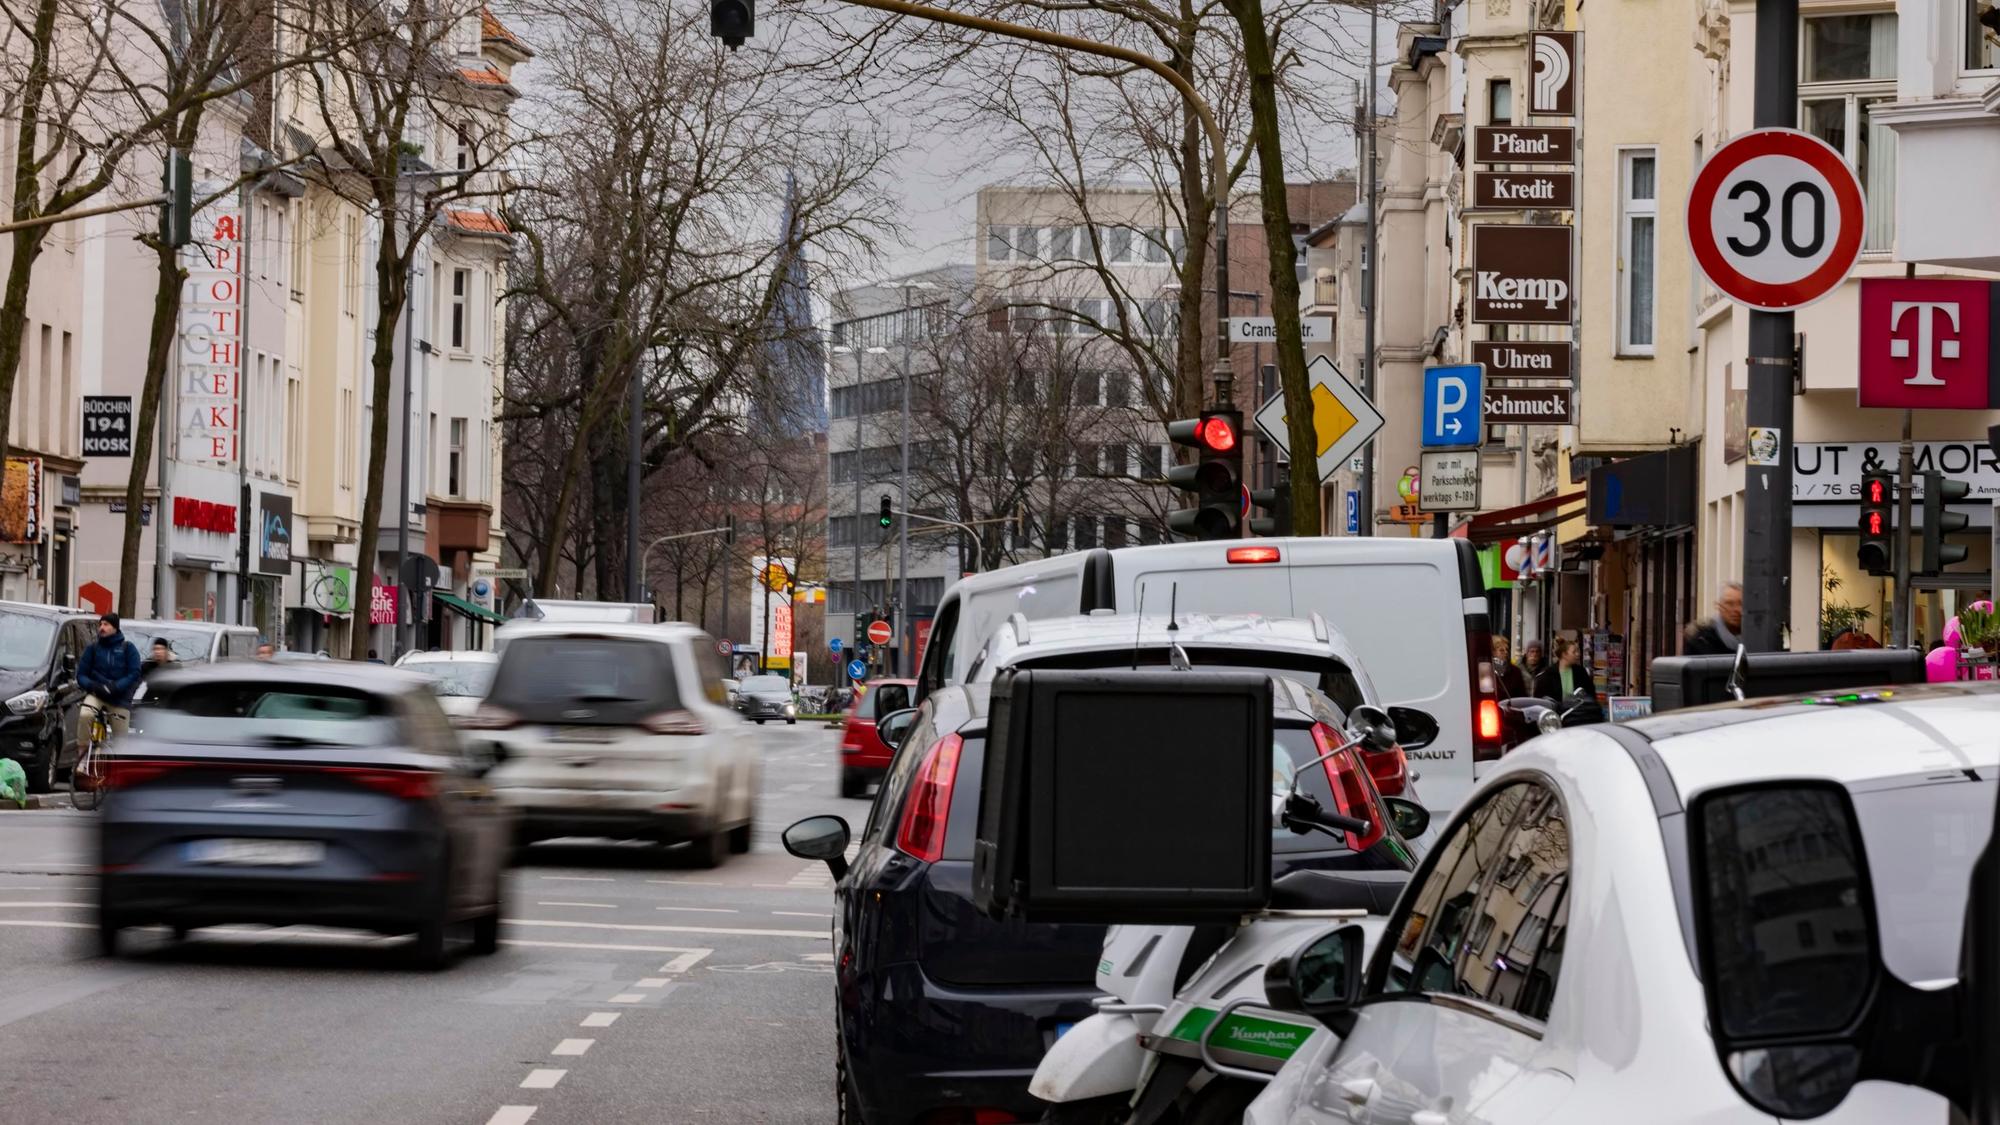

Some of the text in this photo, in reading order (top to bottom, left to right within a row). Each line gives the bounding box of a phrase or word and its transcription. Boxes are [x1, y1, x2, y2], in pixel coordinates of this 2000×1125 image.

[1492, 133, 1559, 154] Pfand-
[1493, 179, 1555, 199] Kredit
[1726, 180, 1826, 258] 30
[1476, 271, 1568, 310] Kemp
[210, 215, 236, 457] APOTHEKE
[1242, 321, 1314, 337] Cranatr.
[1492, 348, 1552, 369] Uhren
[84, 400, 131, 414] BÜDCHEN
[1436, 376, 1468, 437] P
[1484, 395, 1566, 415] Schmuck
[88, 417, 126, 432] 194
[84, 438, 129, 451] KIOSK
[1451, 459, 1462, 469] mit
[1794, 446, 1848, 475] UT
[1861, 447, 1885, 474] &
[1823, 484, 1842, 495] 76
[27, 461, 36, 538] KEBAP
[1423, 492, 1452, 504] werktags
[1399, 505, 1426, 515] EI
[371, 586, 390, 598] OL-
[370, 599, 393, 611] GNE
[370, 611, 395, 624] RINT
[1406, 750, 1456, 760] ENAULT
[1229, 1026, 1297, 1041] Kumpan
